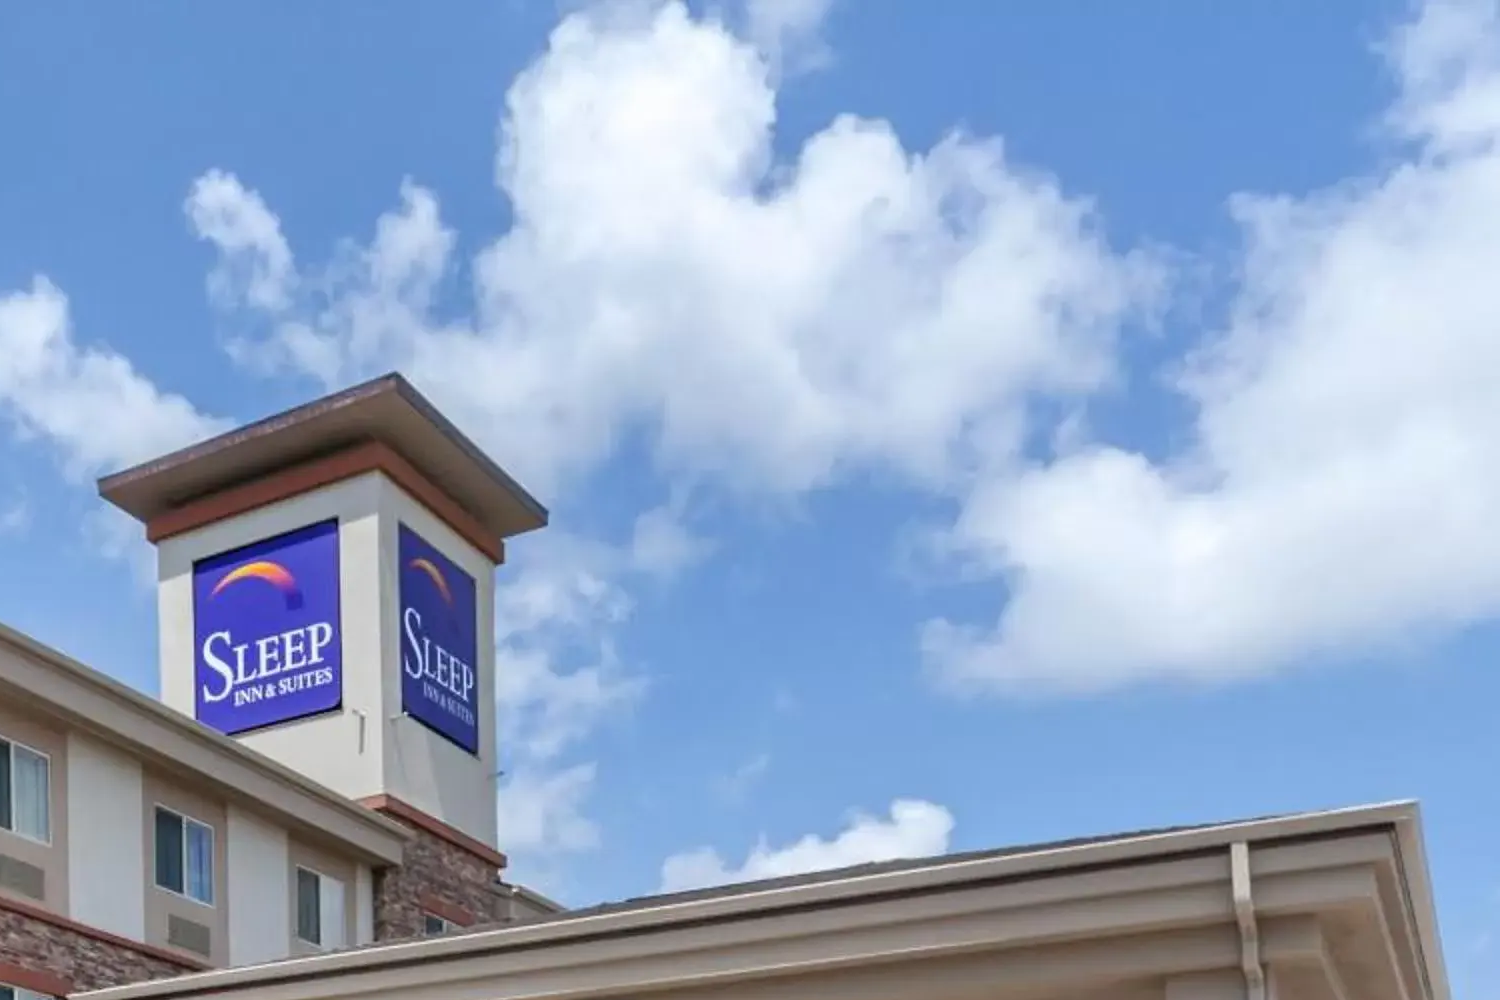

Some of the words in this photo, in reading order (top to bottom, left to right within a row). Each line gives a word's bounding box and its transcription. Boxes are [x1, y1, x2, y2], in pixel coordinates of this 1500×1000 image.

[203, 622, 333, 703] SLEEP
[233, 684, 264, 707] INN
[264, 683, 277, 698] &
[278, 666, 333, 695] SUITES
[404, 607, 474, 703] SLEEP
